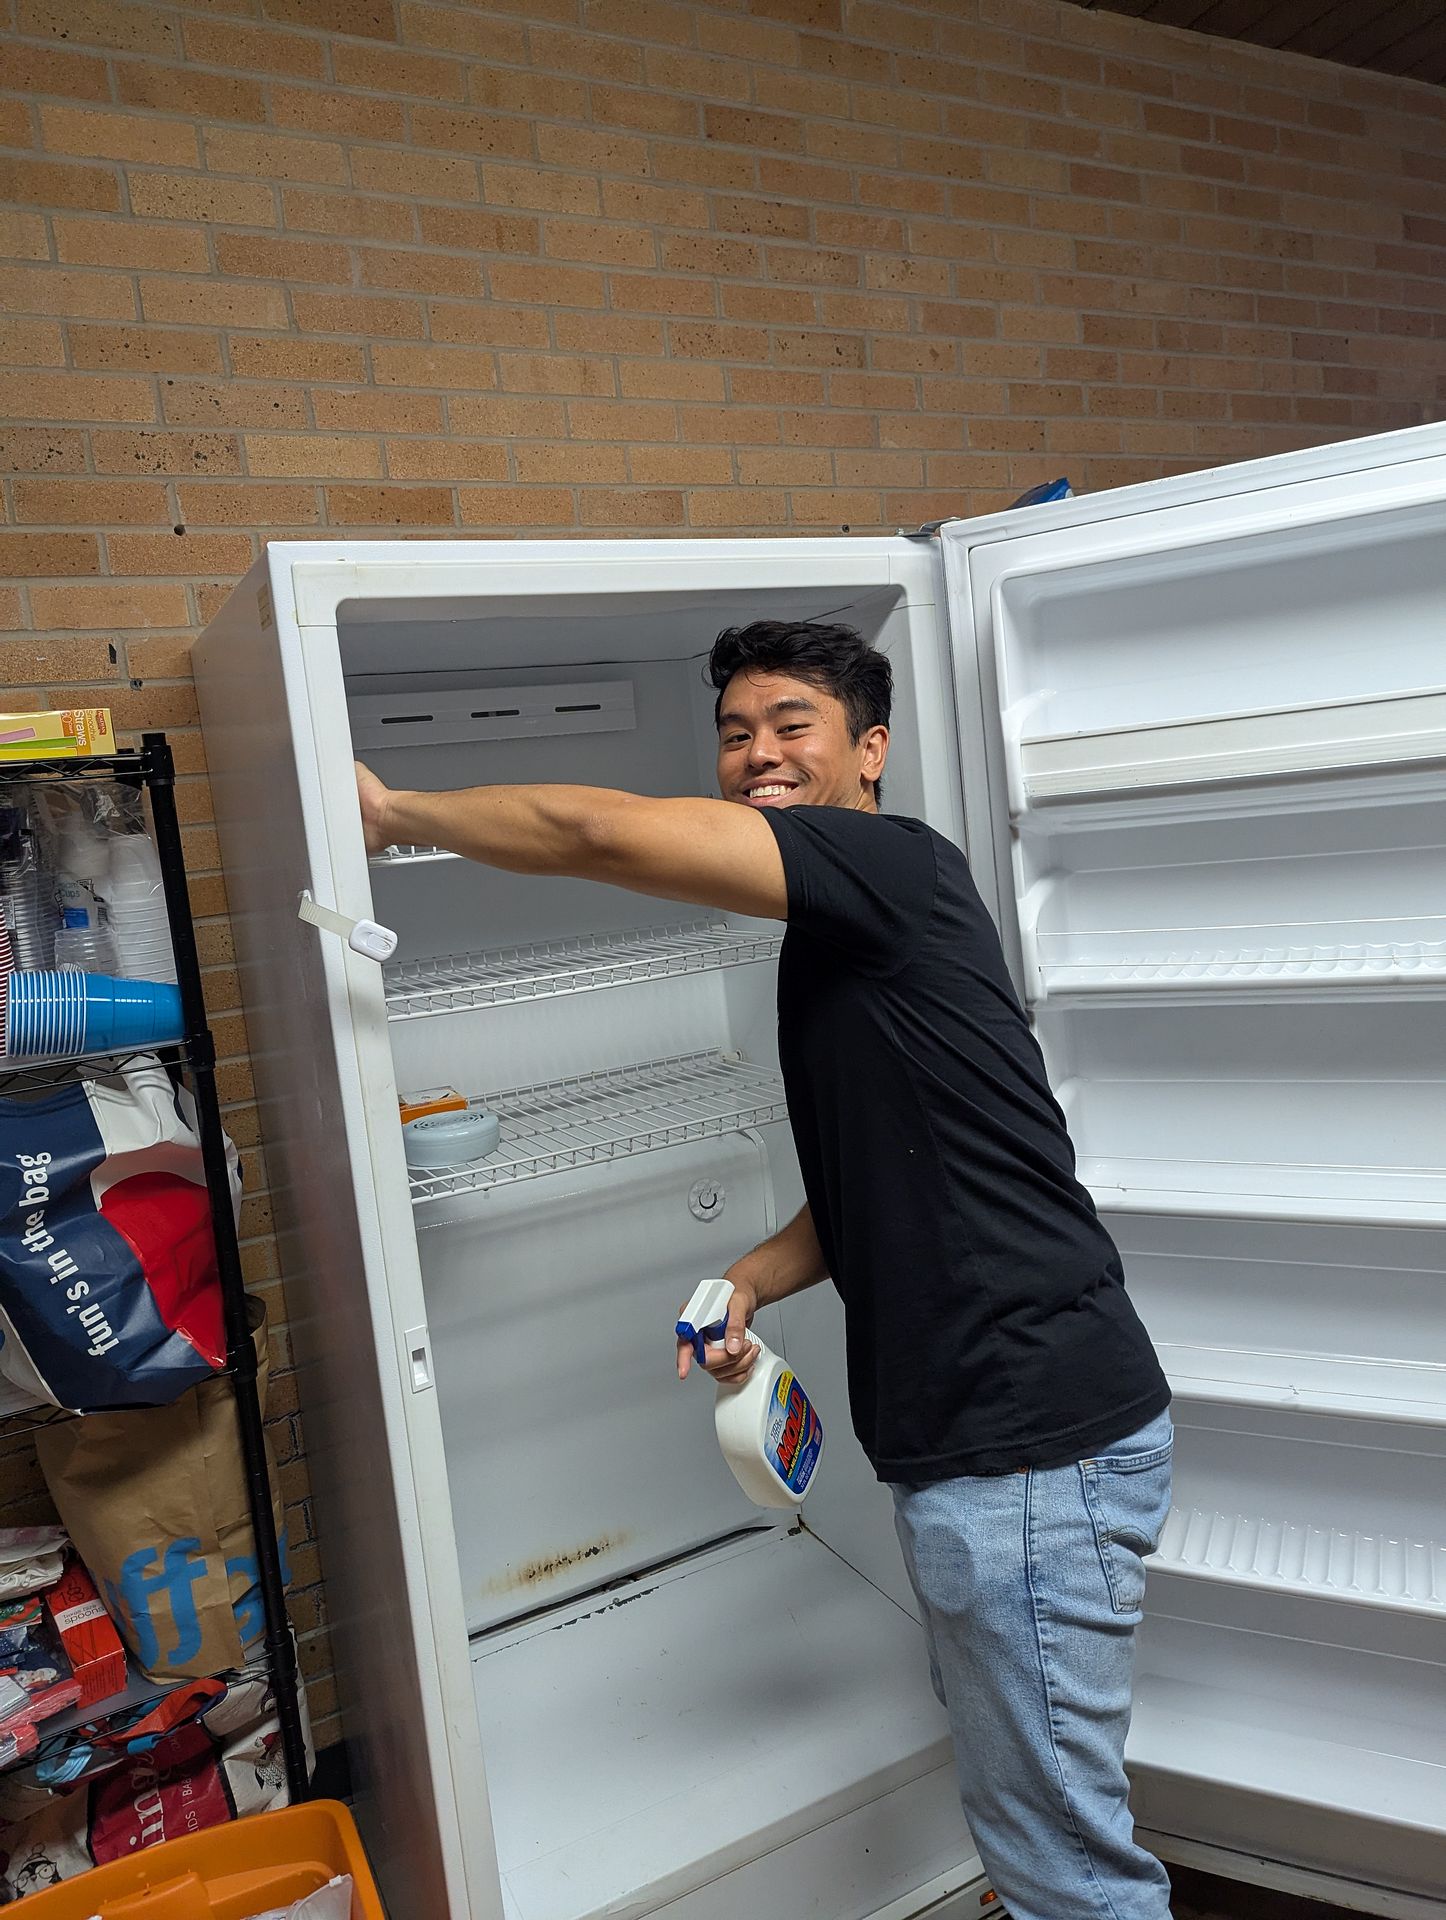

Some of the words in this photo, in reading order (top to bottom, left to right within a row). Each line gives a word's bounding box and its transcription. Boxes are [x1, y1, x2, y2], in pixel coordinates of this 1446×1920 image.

[73, 709, 87, 746] Straws
[16, 1151, 52, 1208] bag
[20, 1209, 55, 1253] the
[47, 1248, 80, 1285] in
[66, 1280, 120, 1357] fun's
[776, 1389, 803, 1471] MOLD
[64, 1606, 105, 1624] spoons
[184, 1811, 200, 1833] IDS
